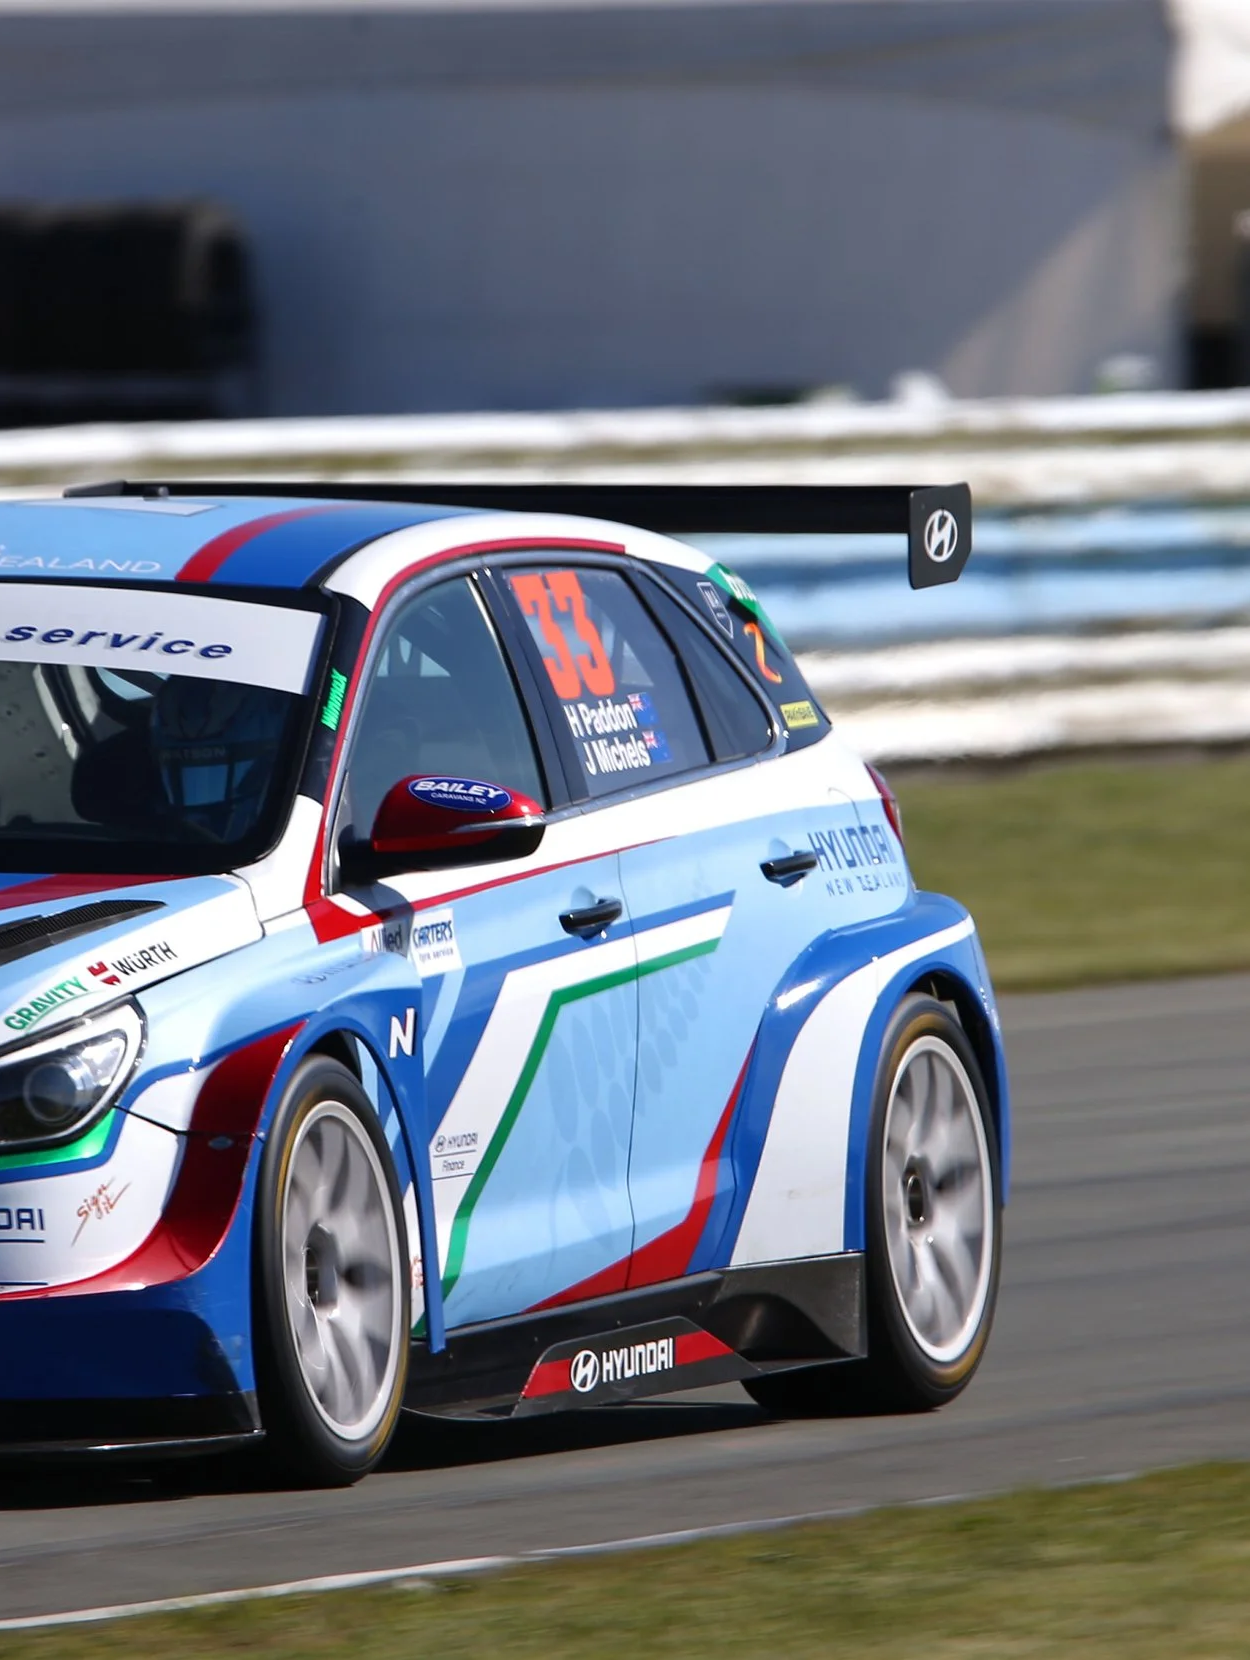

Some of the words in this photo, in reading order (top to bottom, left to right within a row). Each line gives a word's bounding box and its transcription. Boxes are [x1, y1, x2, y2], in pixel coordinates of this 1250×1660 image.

[4, 623, 233, 659] service
[509, 570, 616, 700] 33
[563, 700, 585, 739] H
[578, 695, 638, 737] Paddon
[583, 741, 598, 776] J
[593, 734, 651, 775] Michels
[413, 781, 504, 799] BAILEY
[431, 792, 474, 802] CARAVANS
[475, 796, 487, 805] NZ
[807, 825, 898, 872] HYUNDAI
[371, 922, 403, 952] Allied
[4, 976, 89, 1031] GRAVITY
[389, 1007, 417, 1058] N
[447, 1132, 478, 1149] HYUNDAI
[602, 1337, 674, 1383] HYUNDAI
